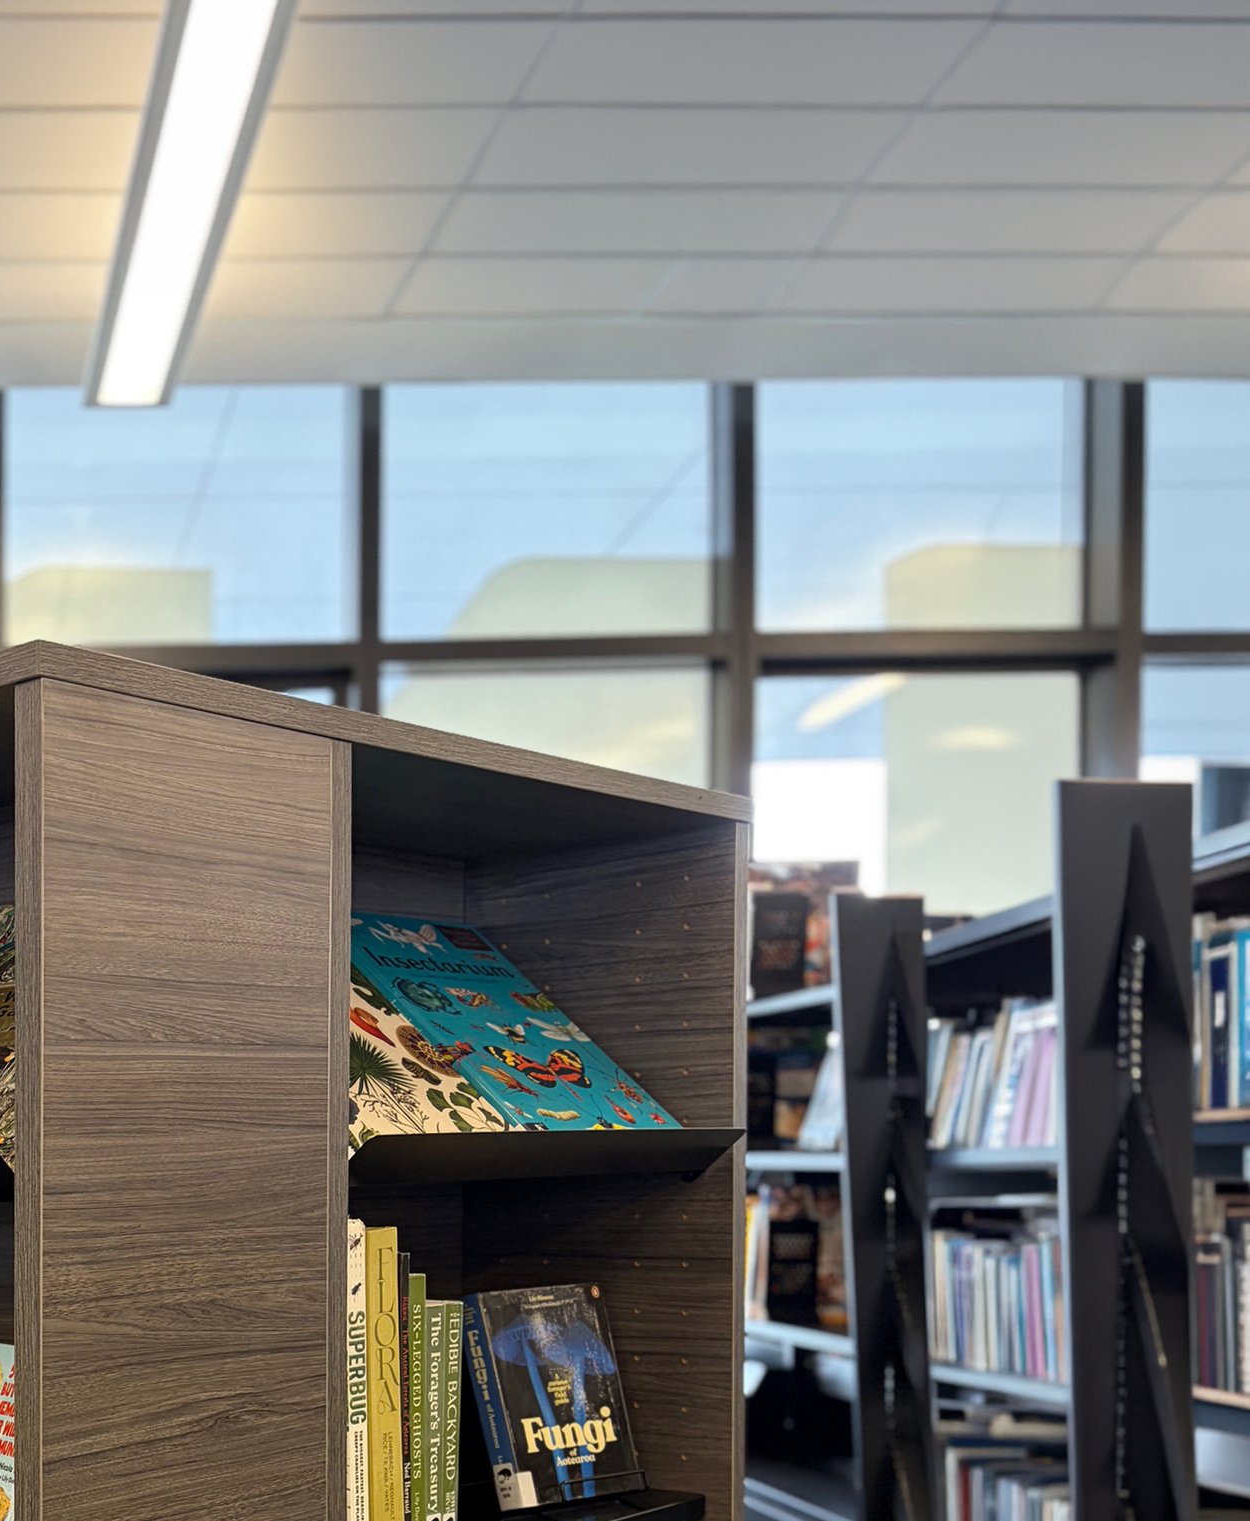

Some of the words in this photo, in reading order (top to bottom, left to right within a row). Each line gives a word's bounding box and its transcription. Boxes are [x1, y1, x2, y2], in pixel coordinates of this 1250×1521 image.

[361, 946, 516, 979] Insectarium
[375, 1246, 400, 1415] FLORA
[413, 1304, 421, 1407] SIX-LEGGED
[431, 1312, 442, 1347] The
[448, 1317, 460, 1375] EDIBLE
[348, 1311, 367, 1425] SUPERBUG
[428, 1351, 442, 1430] Forager's
[467, 1329, 491, 1401] Fungi
[413, 1412, 421, 1479] GHOSTS
[445, 1380, 458, 1481] BACKYARD
[486, 1410, 500, 1449] Aotearoa
[521, 1406, 617, 1453] Fungi
[556, 1454, 596, 1467] Aotearoa
[569, 1448, 579, 1456] of
[427, 1433, 441, 1512] Treasury
